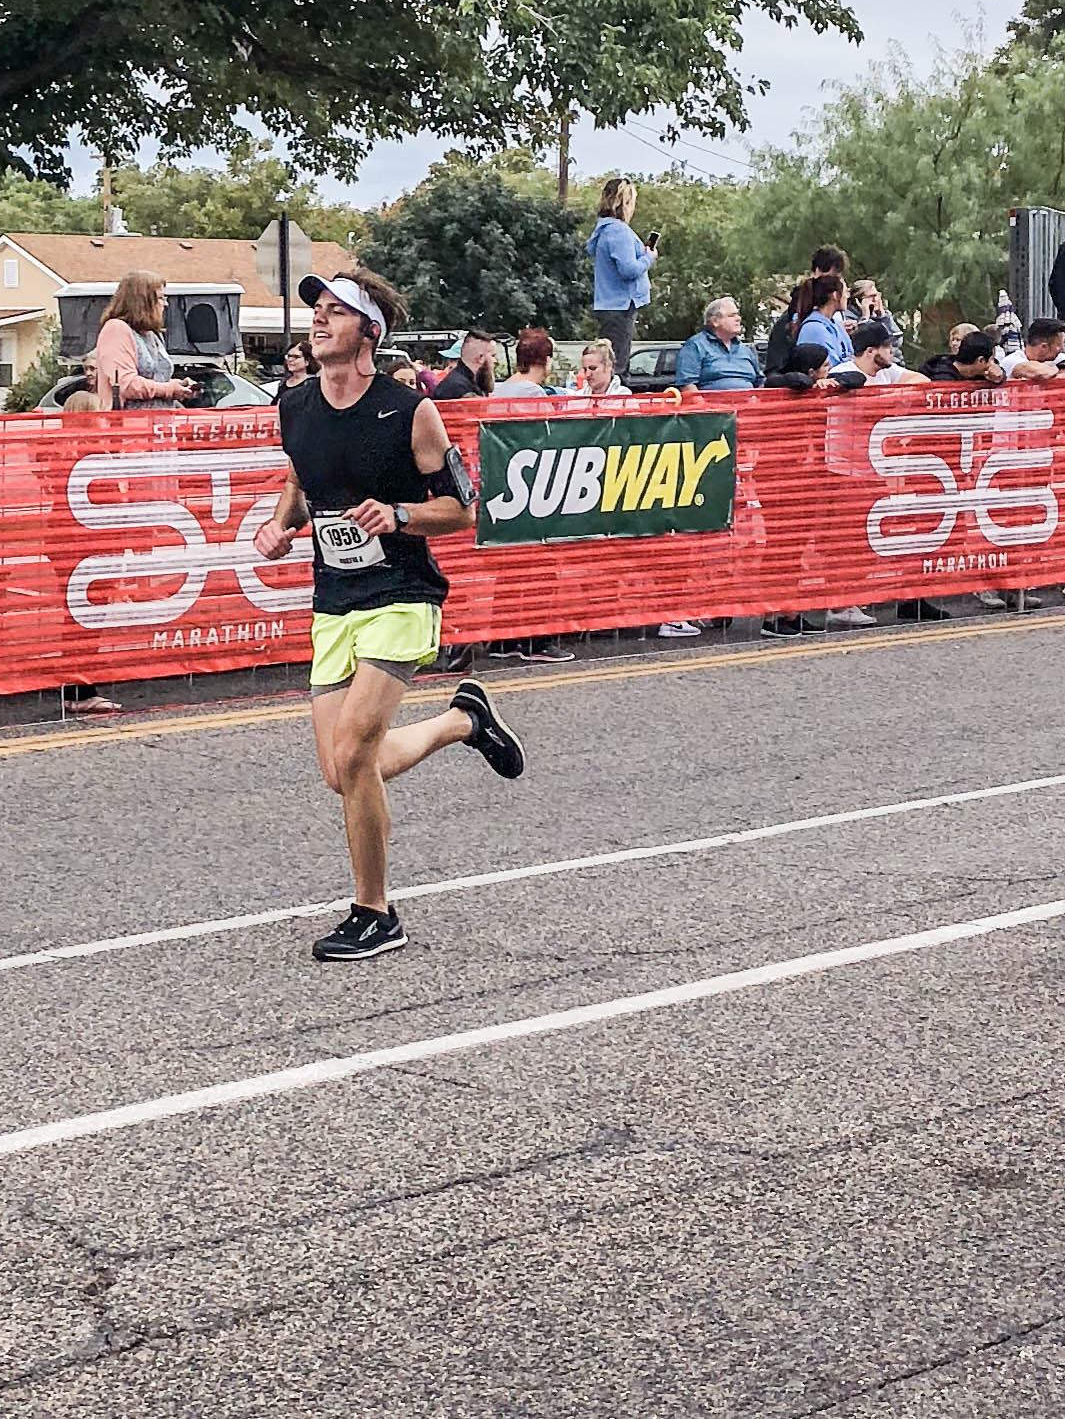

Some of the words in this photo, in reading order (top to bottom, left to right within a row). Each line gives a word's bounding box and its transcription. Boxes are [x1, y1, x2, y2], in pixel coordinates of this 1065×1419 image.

[486, 433, 731, 524] SUBWAY
[326, 526, 362, 547] 1958
[922, 552, 1009, 574] MARATHON
[150, 619, 284, 650] MARATHON
